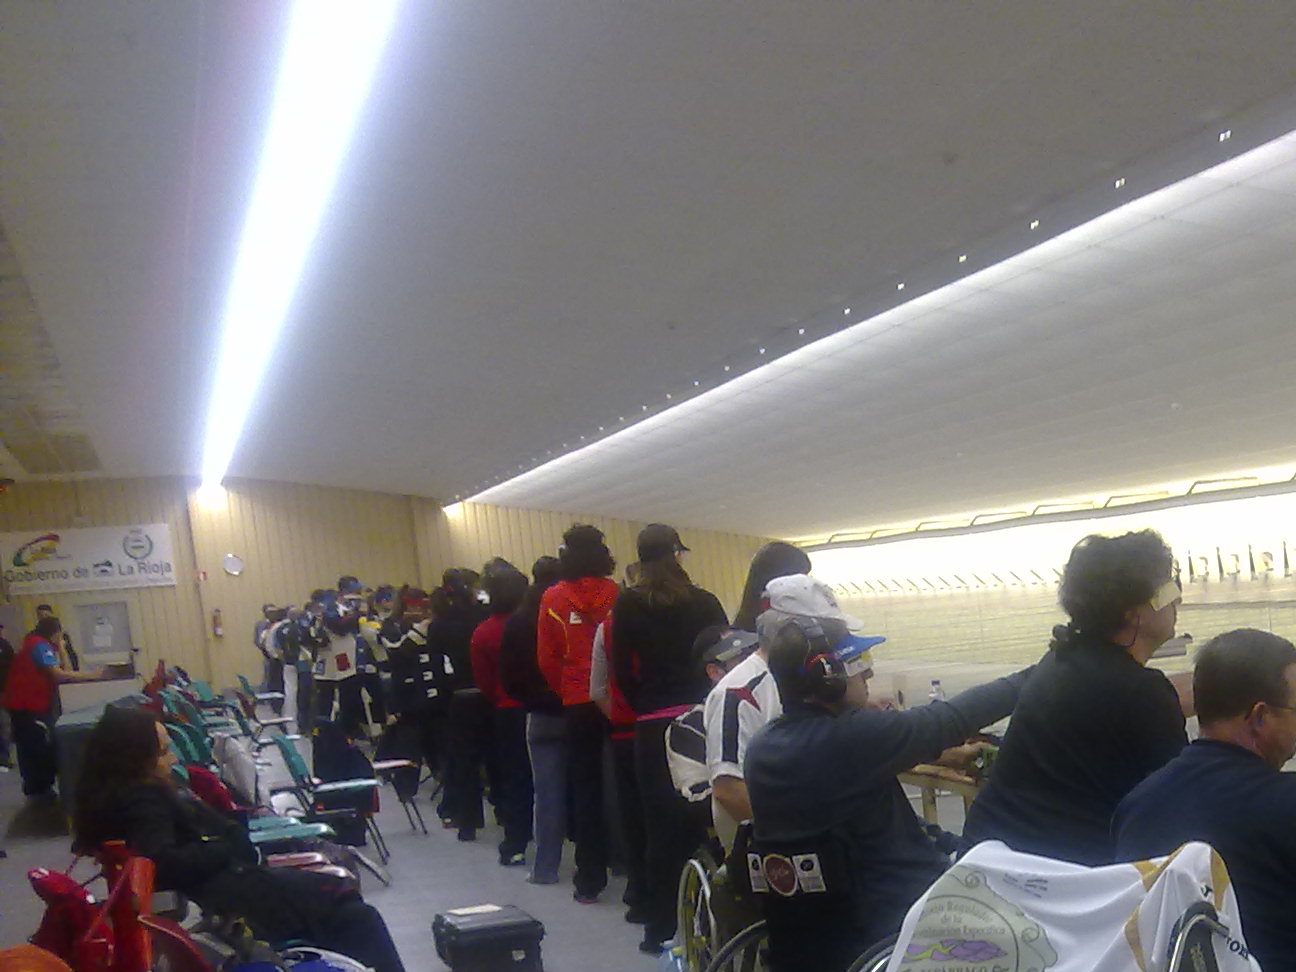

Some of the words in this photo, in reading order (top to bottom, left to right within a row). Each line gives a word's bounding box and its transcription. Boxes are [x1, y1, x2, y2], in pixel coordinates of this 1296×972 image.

[4, 567, 68, 583] Gobierno
[73, 566, 88, 579] de
[118, 563, 134, 576] La
[138, 560, 173, 576] Rioja
